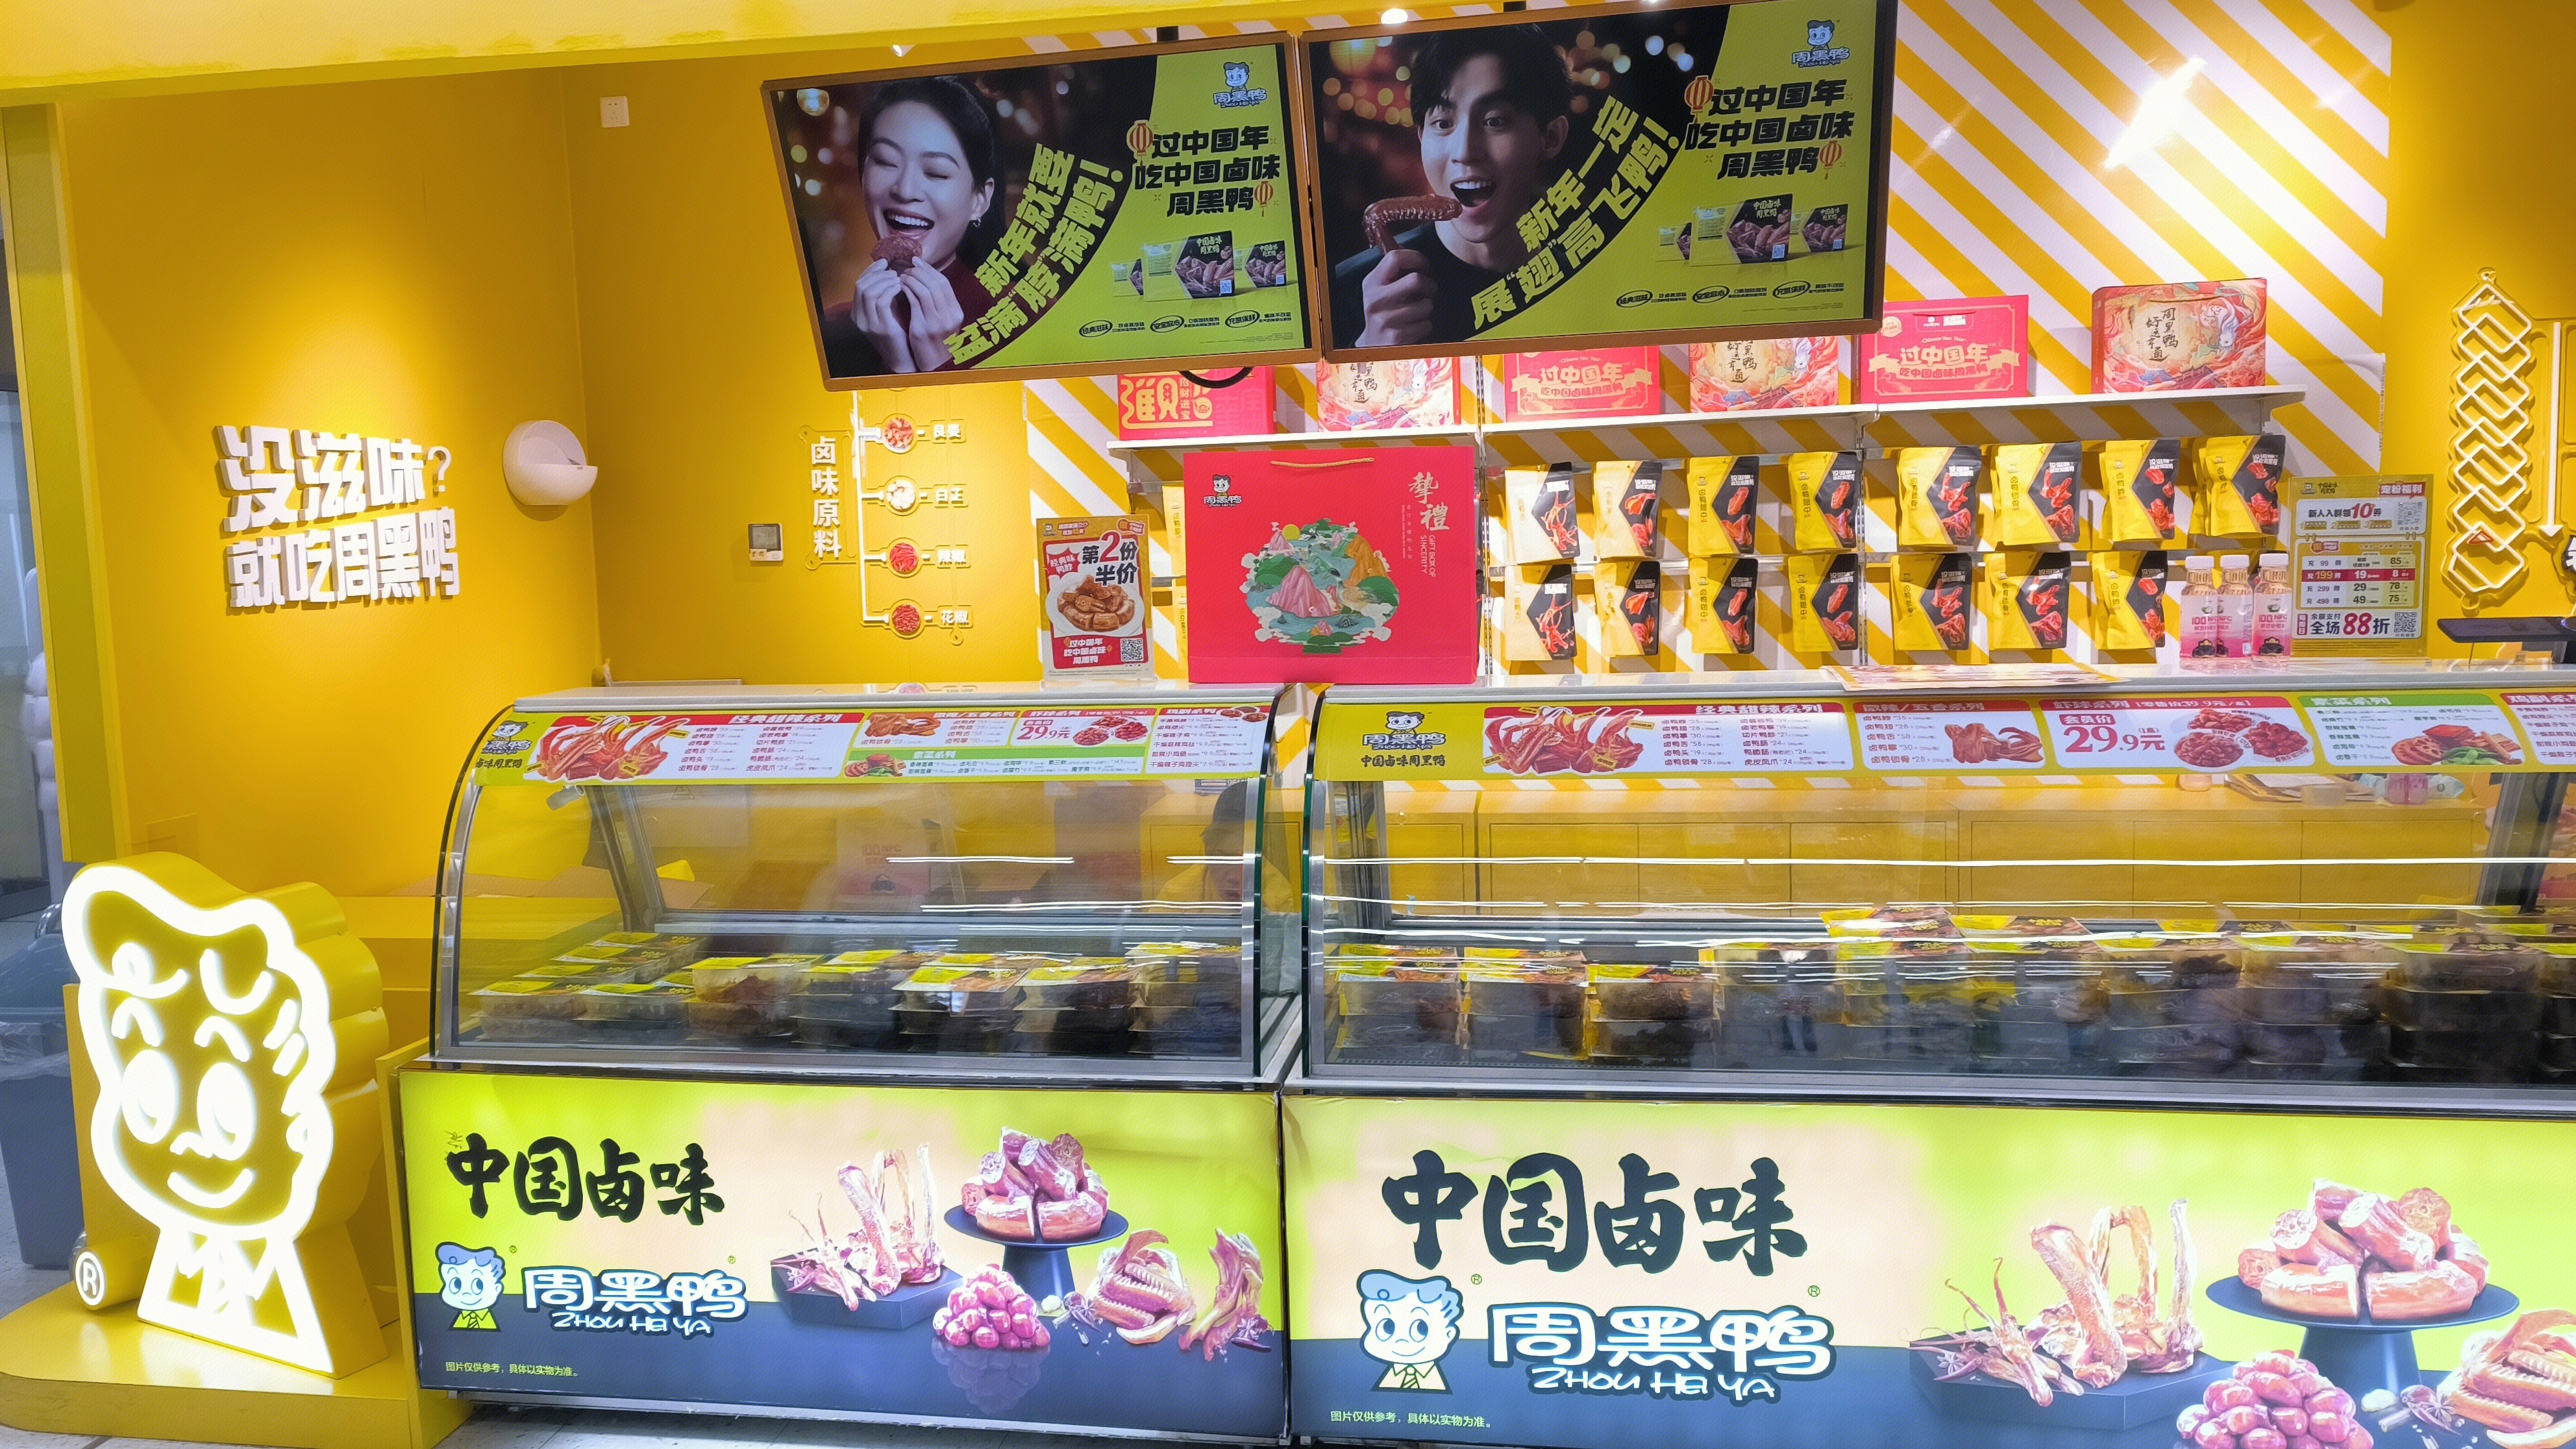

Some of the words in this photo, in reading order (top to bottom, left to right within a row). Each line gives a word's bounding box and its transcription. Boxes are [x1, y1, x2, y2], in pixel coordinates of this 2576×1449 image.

[1708, 79, 1847, 116] 过中国年
[1152, 126, 1269, 158] 过中国年
[1685, 110, 1855, 150] 吃中国卤味
[1135, 155, 1280, 190] 吃中国卤味
[1516, 95, 1639, 253] 新年一定
[1717, 147, 1820, 180] 周黑鸭
[1167, 186, 1254, 217] 周黑鸭
[973, 143, 1074, 298] 新年就要
[1900, 342, 1988, 366] 过中国年
[1541, 362, 1623, 386] 过中国年
[215, 425, 452, 532] 没滋味？
[811, 436, 841, 558] 卤味原料
[228, 506, 460, 608] 就吃周黑鸭
[1082, 531, 1138, 564] 第2份
[1095, 563, 1138, 586] 半价
[2353, 583, 2366, 591] 29
[2355, 570, 2367, 579] 19
[2310, 612, 2390, 636] 全场88折
[728, 714, 843, 724] 经典甜辣系列
[1696, 704, 1823, 714] 经典甜辣系列
[2064, 715, 2112, 724] 会员价
[1017, 726, 1071, 739] 29.9元
[1363, 734, 1445, 745] 周黑鸭
[2063, 726, 2166, 752] 29.9元
[1361, 754, 1446, 767] 中国卤味周黑鸭
[446, 1132, 725, 1226] 中国卤味
[1381, 1149, 1807, 1277] 中国卤味
[524, 1267, 747, 1319] 周黑鸭
[551, 1311, 625, 1330] ZHOU
[672, 1316, 712, 1336] YA
[1492, 1305, 1831, 1376] 周黑鸭
[1531, 1366, 1642, 1391] ZHOU
[1717, 1373, 1776, 1402] YA
[1330, 1411, 1492, 1429] 图片仅供参考，具体以实物为准。
